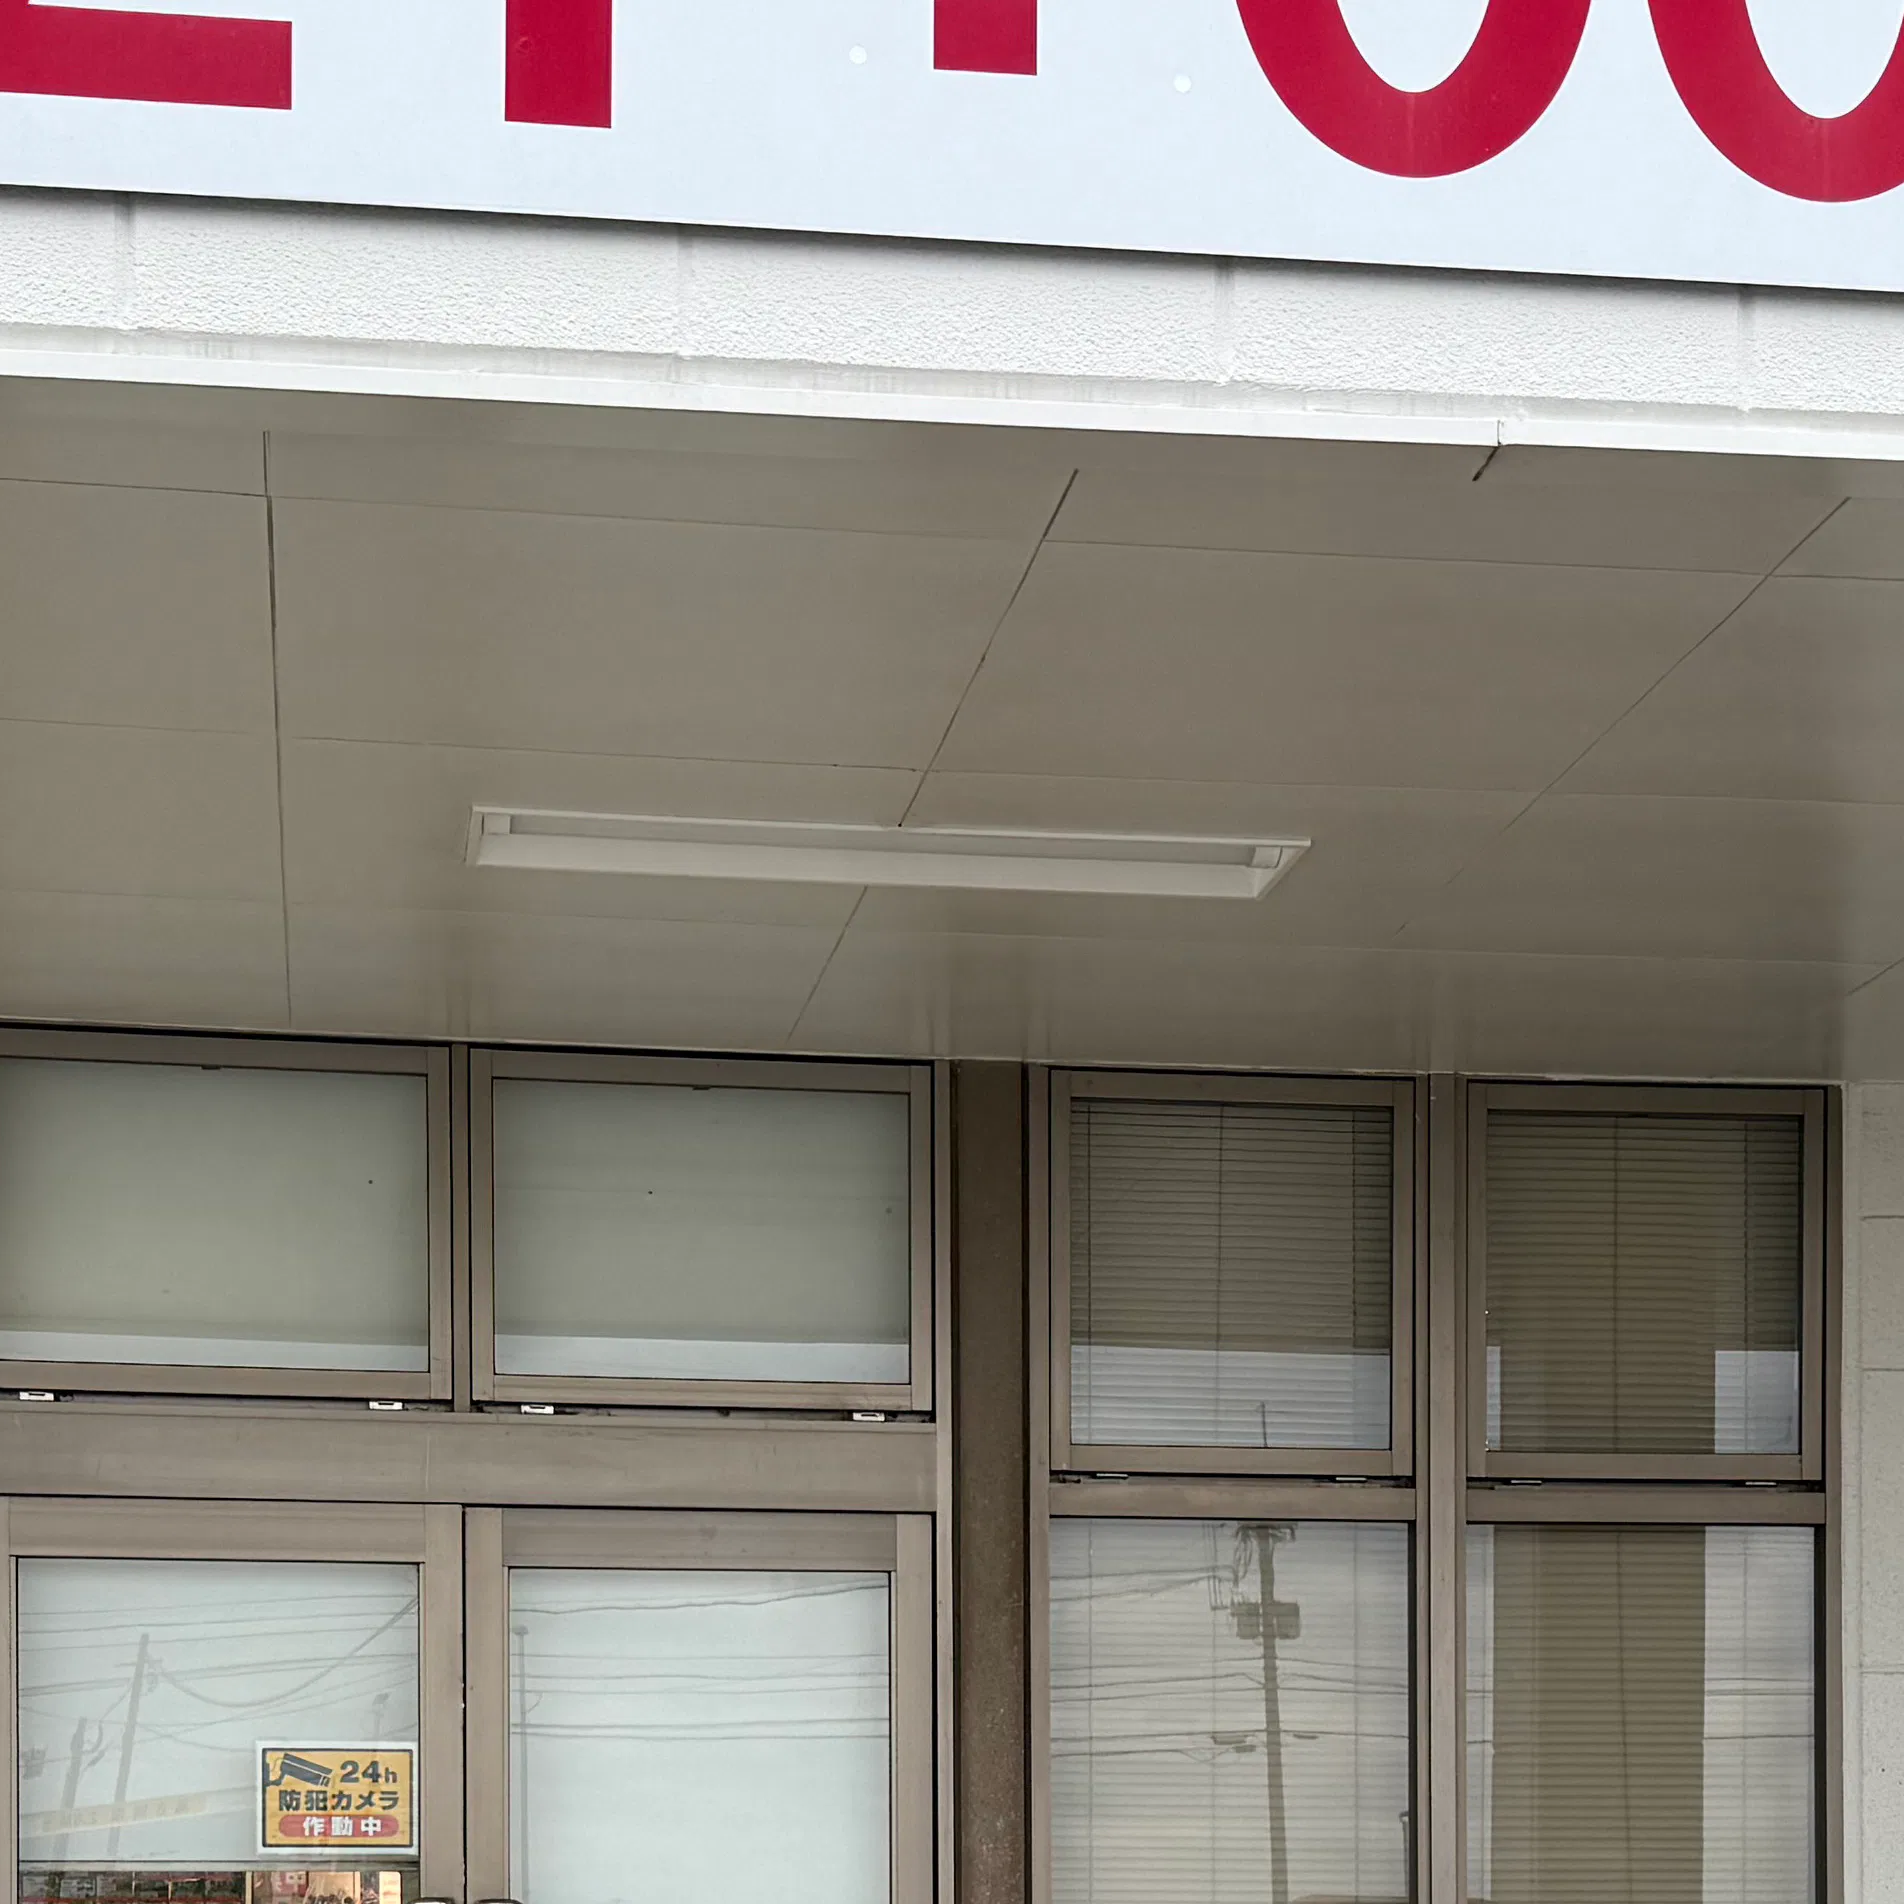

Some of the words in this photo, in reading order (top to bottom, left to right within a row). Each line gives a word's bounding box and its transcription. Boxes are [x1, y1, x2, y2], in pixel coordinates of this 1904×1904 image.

[339, 1760, 398, 1784] 24h
[279, 1790, 399, 1812] 防犯カメラ
[302, 1816, 382, 1837] 作動中
